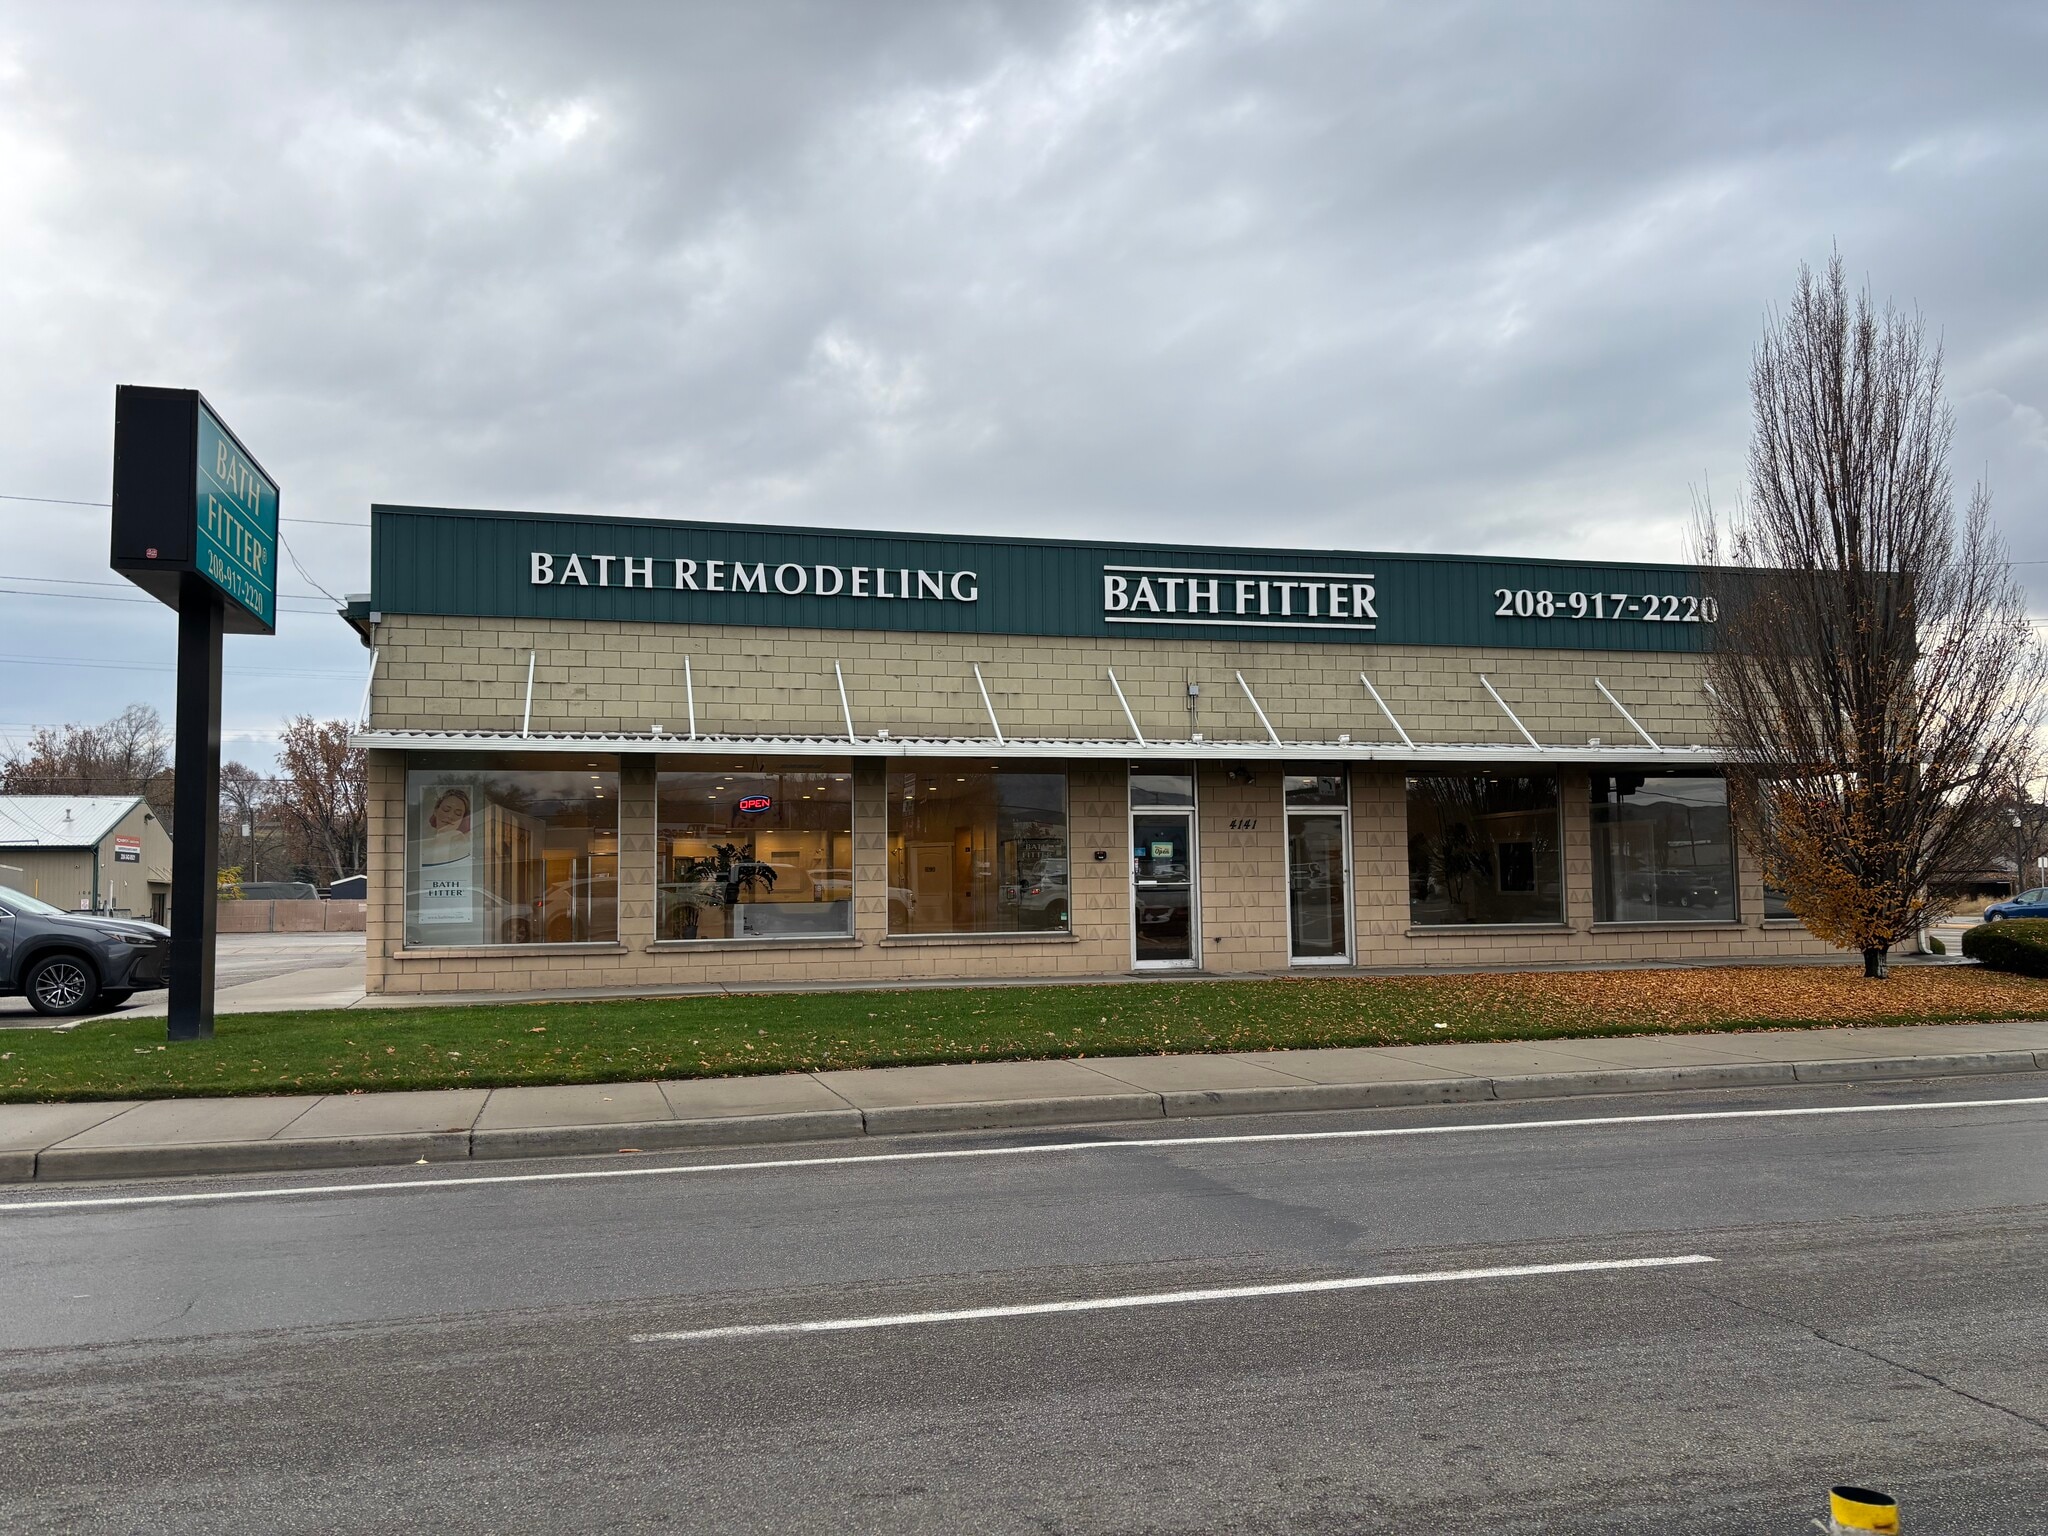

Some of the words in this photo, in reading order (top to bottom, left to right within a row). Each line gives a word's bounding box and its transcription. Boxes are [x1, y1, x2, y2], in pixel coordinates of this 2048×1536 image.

[216, 439, 261, 516] BATH
[207, 548, 263, 615] 208-917-2220
[530, 552, 653, 588] BATH
[674, 558, 978, 602] REMODELING
[1103, 575, 1219, 614] BATH
[1235, 579, 1378, 618] FITTER
[1494, 588, 1719, 623] 208-917-2220
[739, 799, 770, 809] OPEN
[1229, 818, 1257, 830] 4141
[1154, 848, 1170, 856] Open
